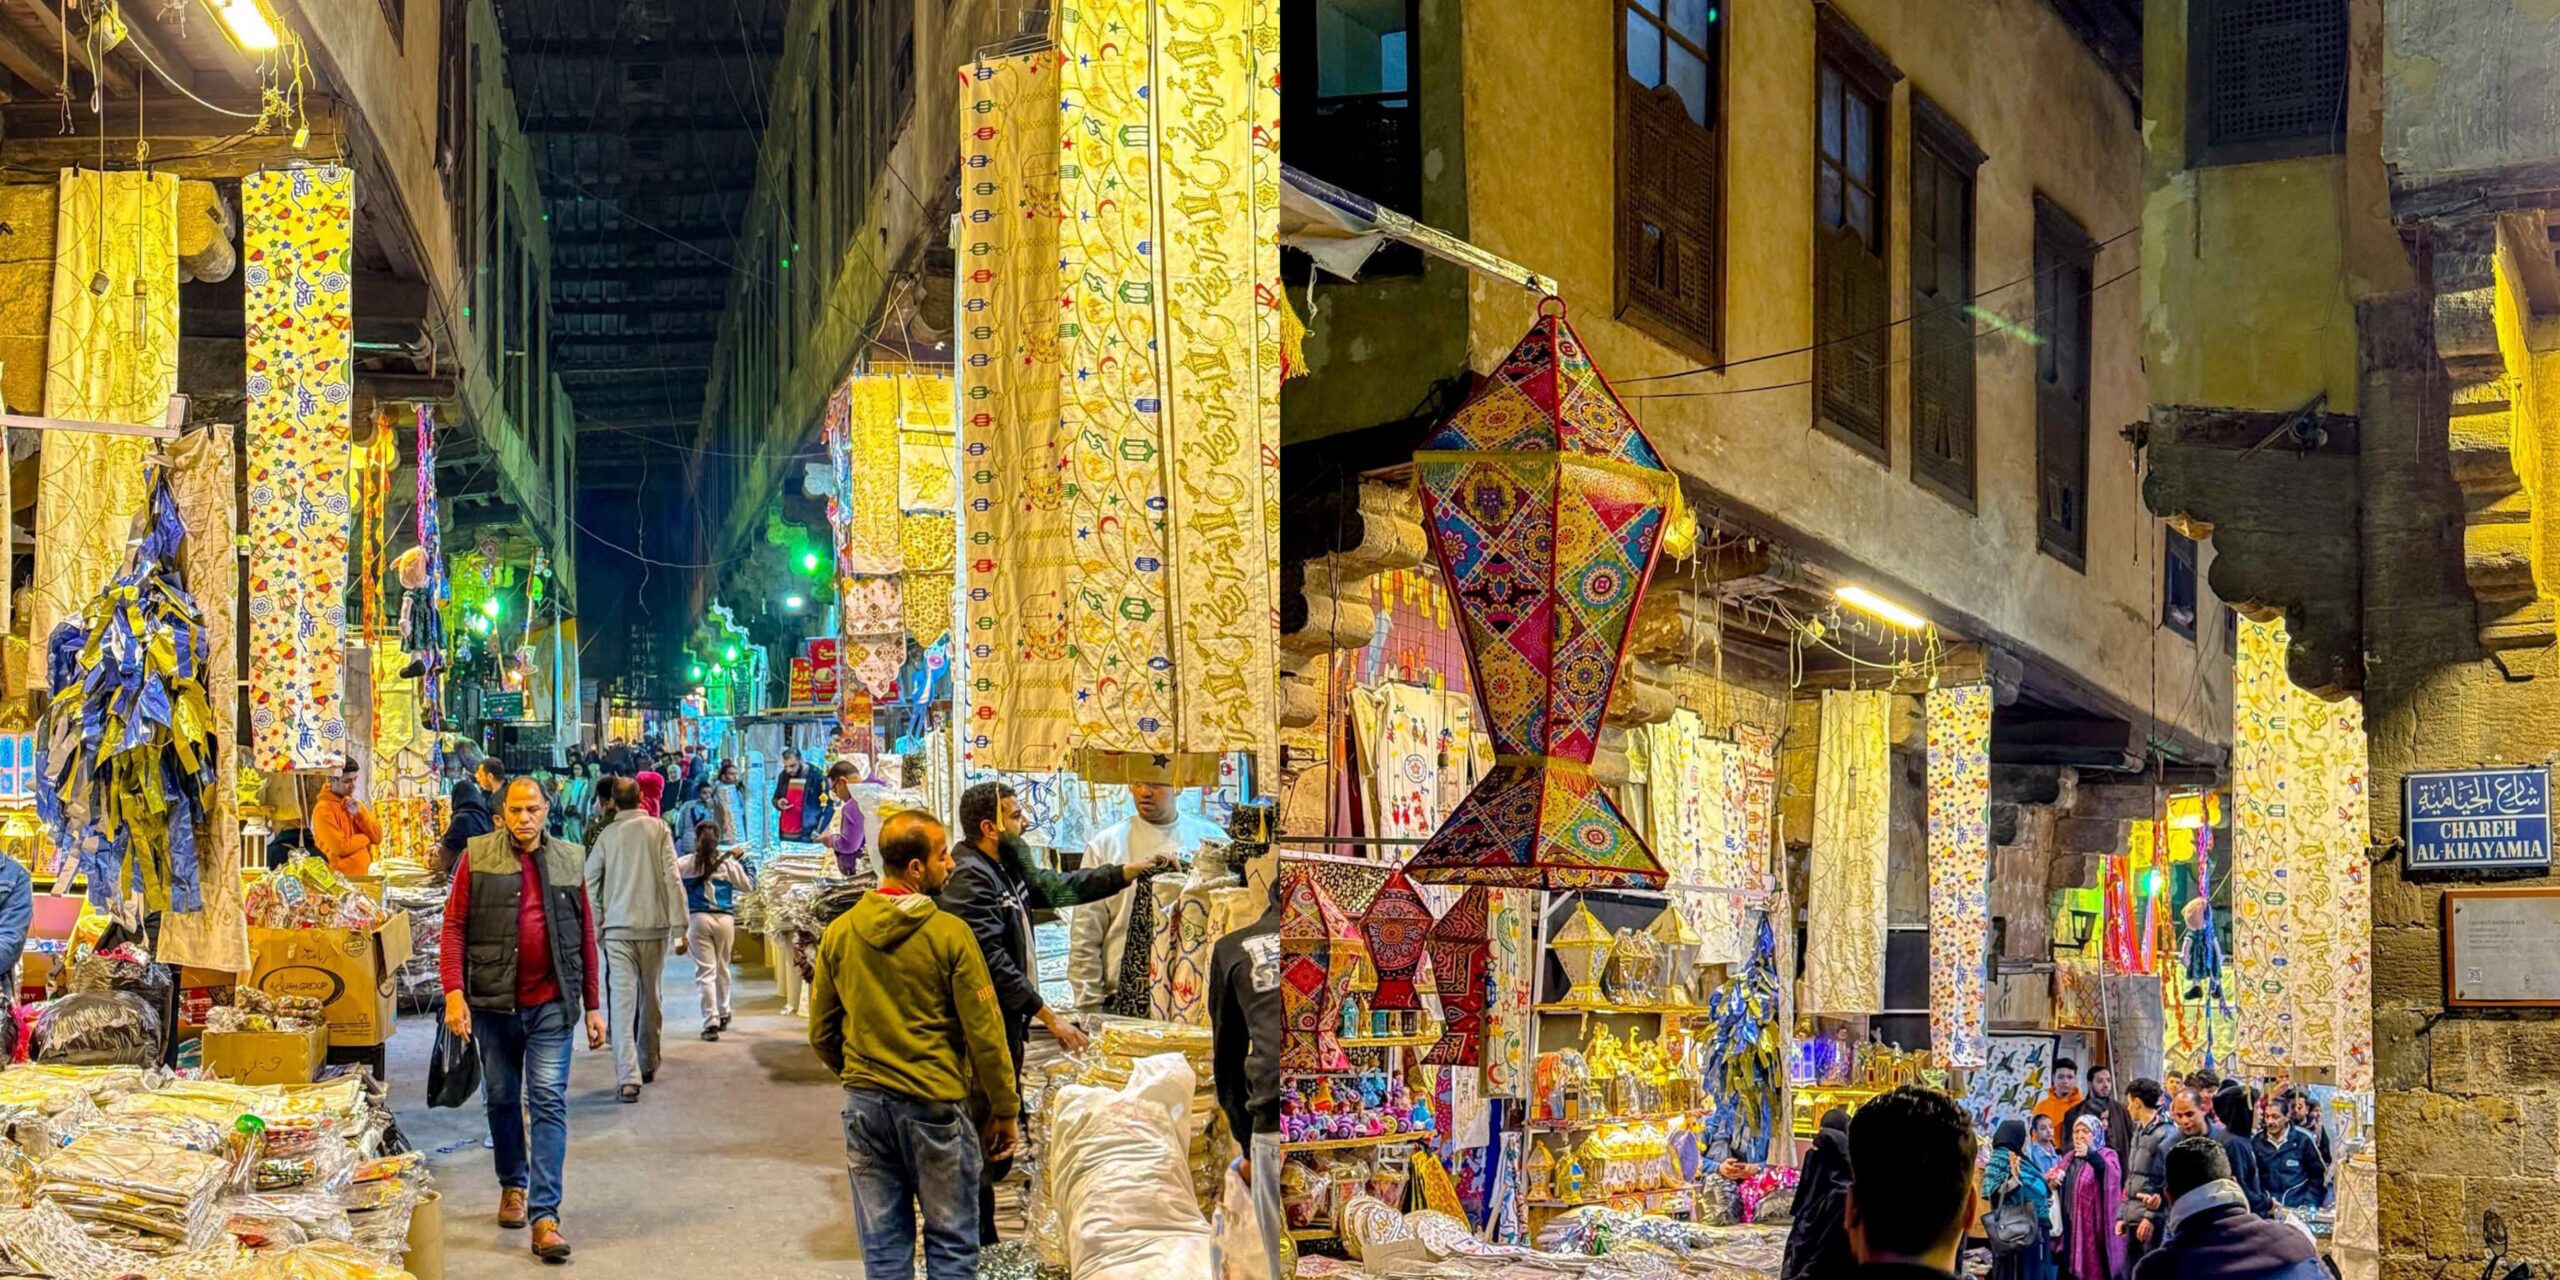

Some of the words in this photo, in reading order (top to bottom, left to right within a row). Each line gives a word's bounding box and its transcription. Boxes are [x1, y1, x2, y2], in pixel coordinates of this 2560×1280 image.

[2417, 776, 2493, 815] الخيامية
[2494, 775, 2540, 814] شارع
[2440, 820, 2517, 839] CHAREH
[2416, 840, 2543, 860] AL-KHAYAMIA
